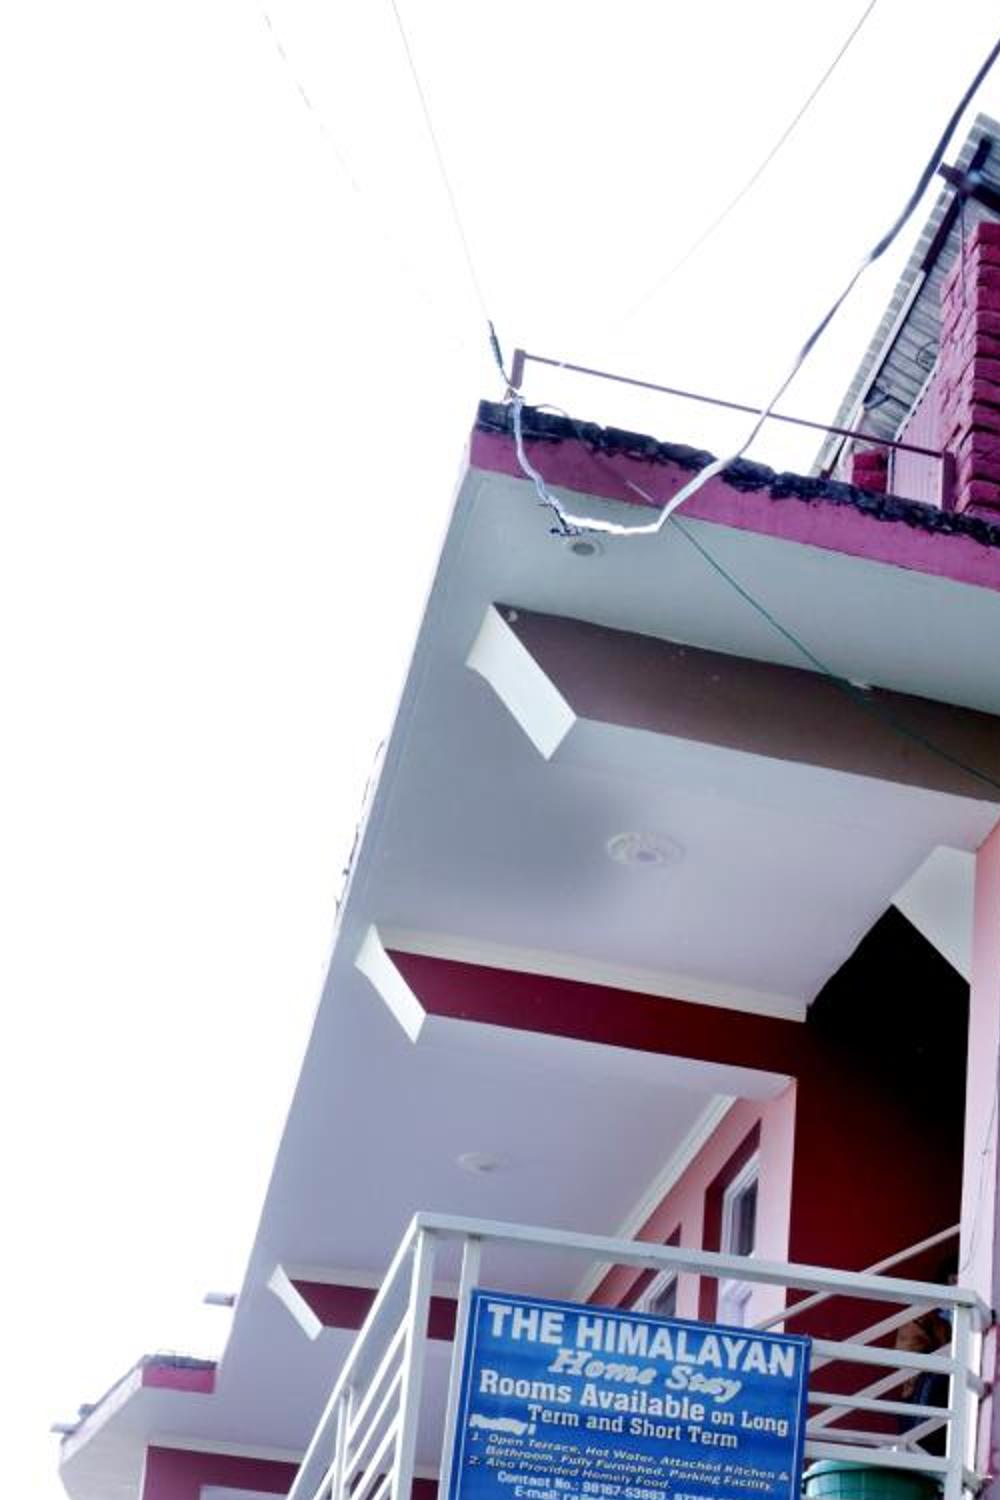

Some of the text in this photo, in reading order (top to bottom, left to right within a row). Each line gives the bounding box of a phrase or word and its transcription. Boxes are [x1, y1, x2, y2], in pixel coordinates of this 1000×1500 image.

[487, 1303, 796, 1378] THE HIMALAYAN
[547, 1348, 743, 1404] Home Stay
[479, 1369, 789, 1437] Rooms Available on Long
[527, 1403, 579, 1427] Term
[586, 1415, 623, 1433] and
[629, 1418, 681, 1441] Short
[687, 1425, 738, 1448] Term
[486, 1457, 515, 1470] Also
[520, 1460, 579, 1477] Provided
[582, 1469, 631, 1485] Homely
[488, 1433, 524, 1447] Open
[586, 1445, 609, 1457] Hot
[660, 1456, 721, 1473] Attached
[561, 1454, 592, 1468] Fully
[669, 1469, 720, 1486] Parking
[497, 1470, 550, 1489] Contact
